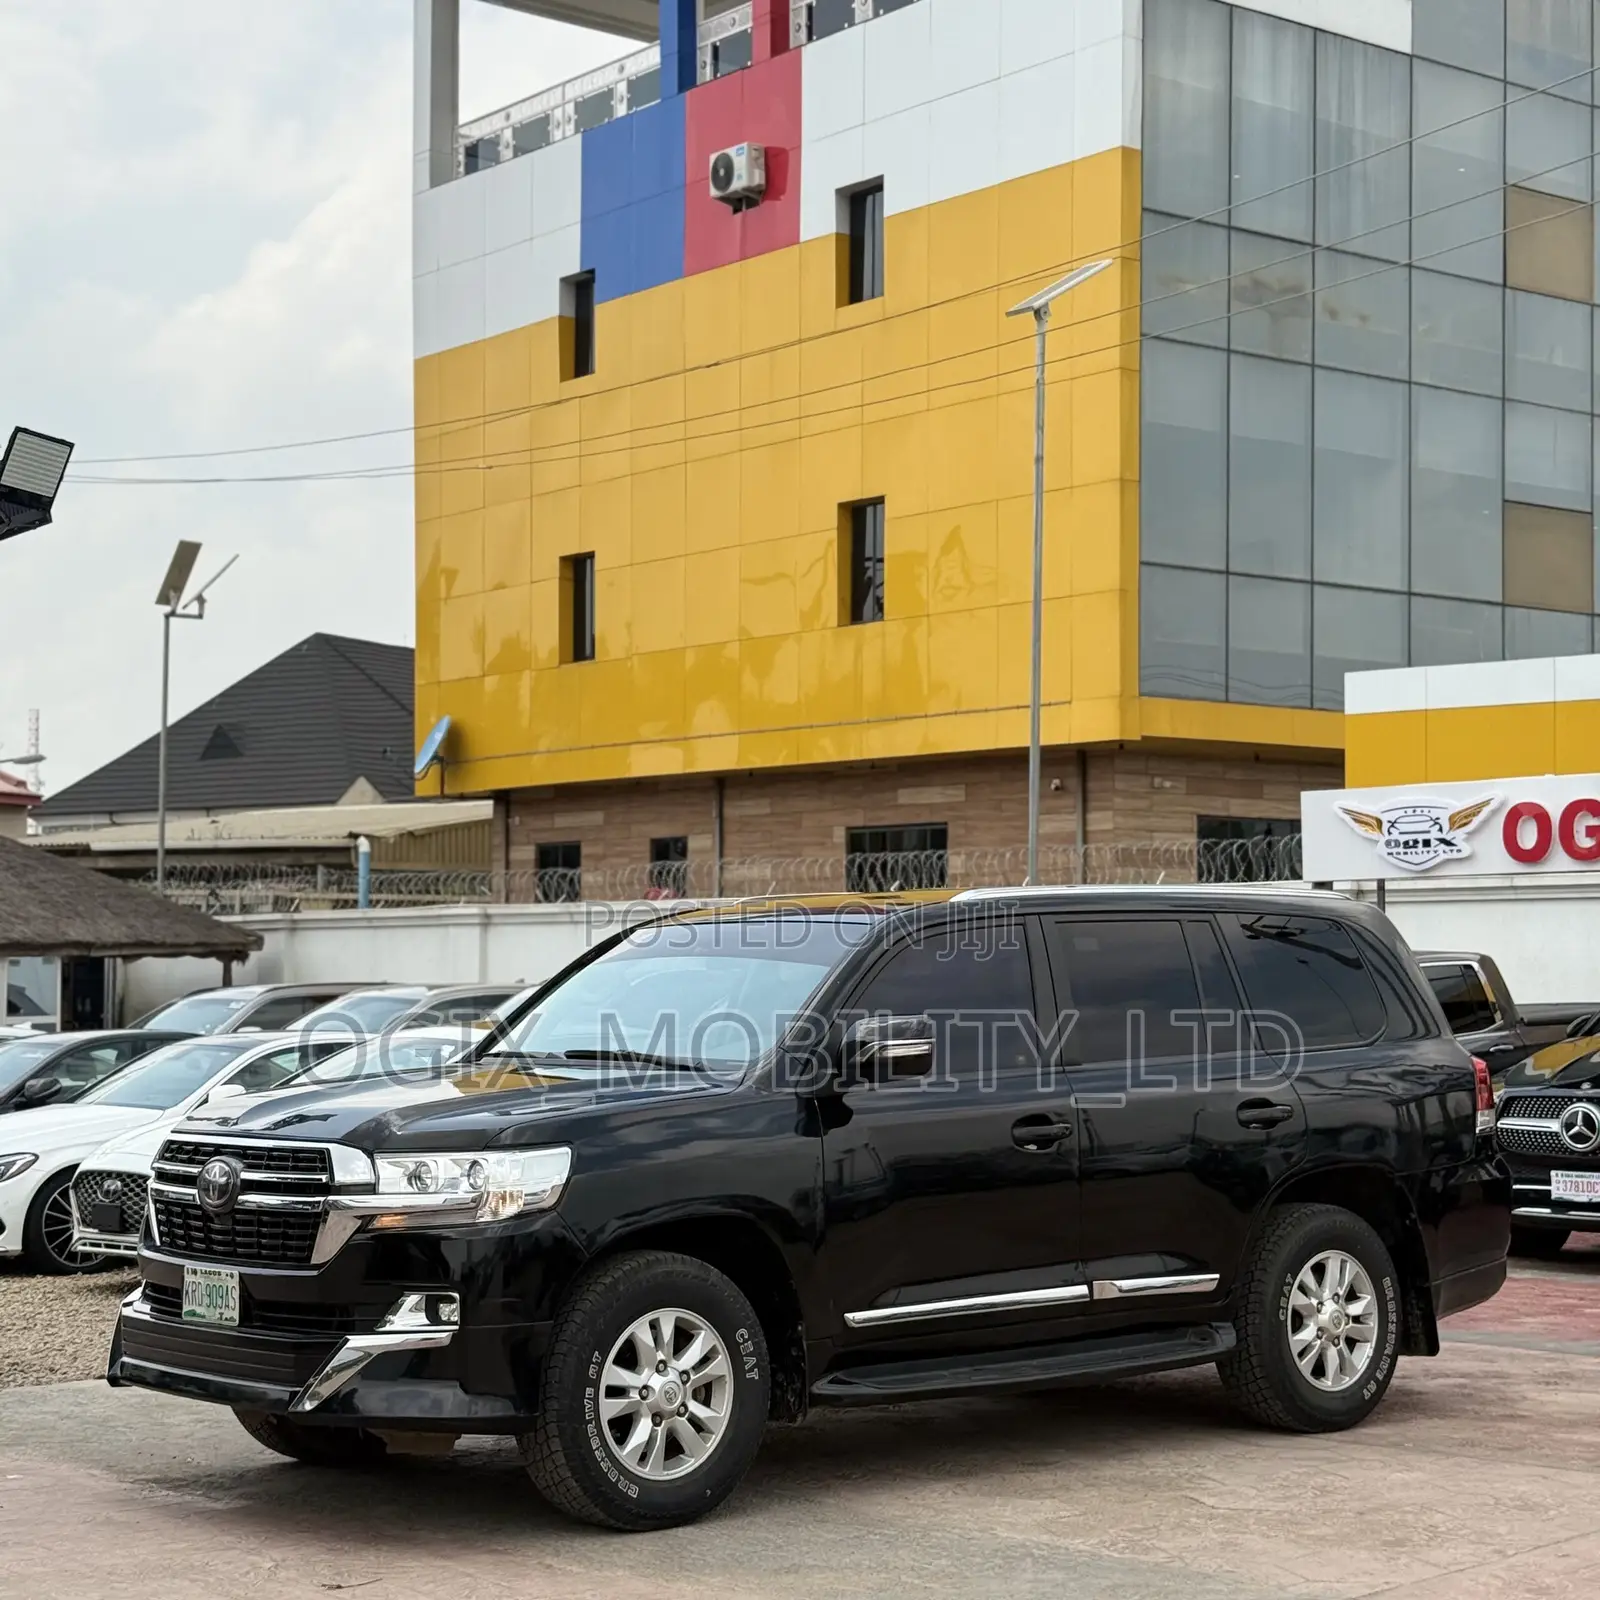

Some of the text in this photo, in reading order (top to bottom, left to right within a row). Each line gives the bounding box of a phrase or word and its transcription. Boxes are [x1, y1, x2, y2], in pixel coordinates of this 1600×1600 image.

[200, 1269, 222, 1277] LAGOS
[1278, 1273, 1294, 1321] CEAT
[735, 1327, 759, 1380] CEAT
[1376, 1276, 1397, 1382] CROSSDRIVE
[584, 1350, 640, 1499] CROSSDRIVE AT
